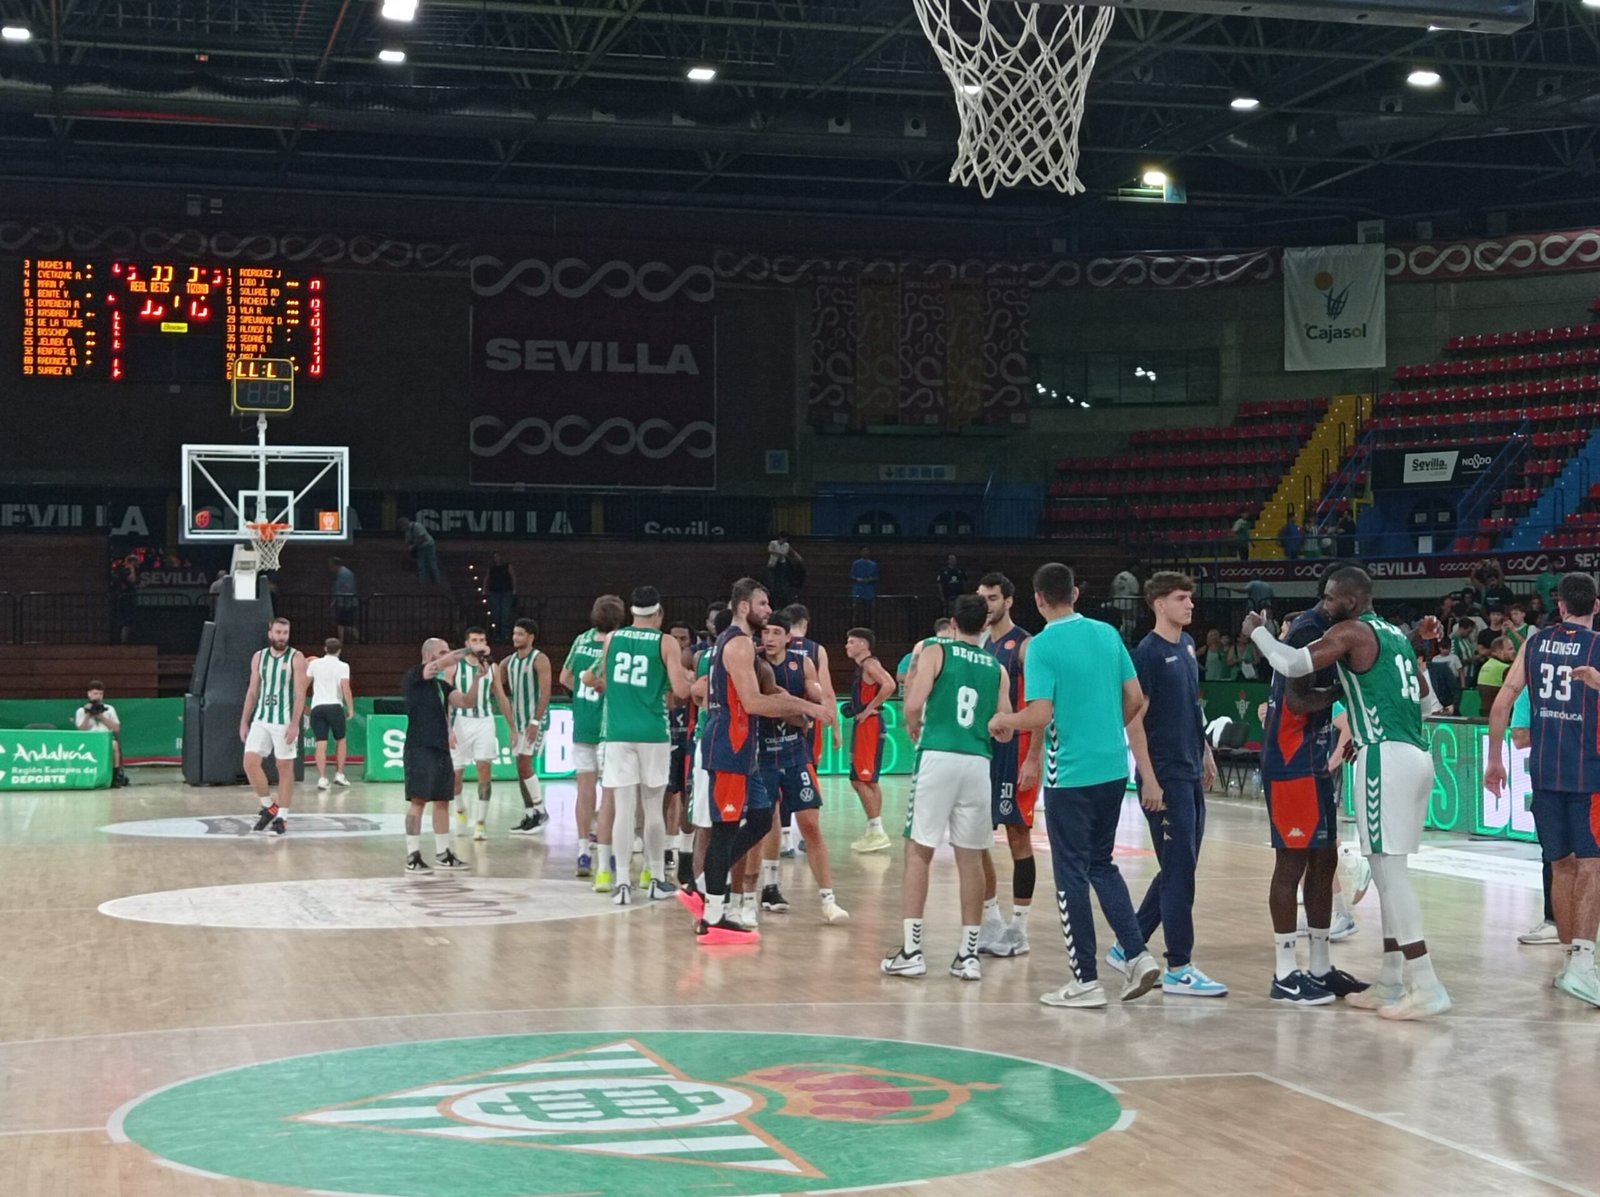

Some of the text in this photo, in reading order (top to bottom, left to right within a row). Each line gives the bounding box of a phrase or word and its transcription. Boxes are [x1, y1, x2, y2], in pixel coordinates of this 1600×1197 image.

[38, 260, 64, 270] HUGHES
[50, 318, 60, 326] LA
[1304, 323, 1366, 344] Cajasol
[486, 338, 699, 375] SEVILLA
[1368, 562, 1426, 576] SEVILLA
[139, 572, 208, 586] SEVILLA
[1538, 639, 1581, 656] ALONSO
[952, 646, 993, 667] BENITE
[613, 652, 648, 687] 22
[1539, 662, 1573, 702] 33
[957, 686, 978, 729] 8
[12, 743, 98, 762] Andalucía
[12, 766, 42, 776] Región
[44, 766, 81, 774] Europea
[12, 775, 66, 784] DEPORTE
[800, 772, 811, 786] 9
